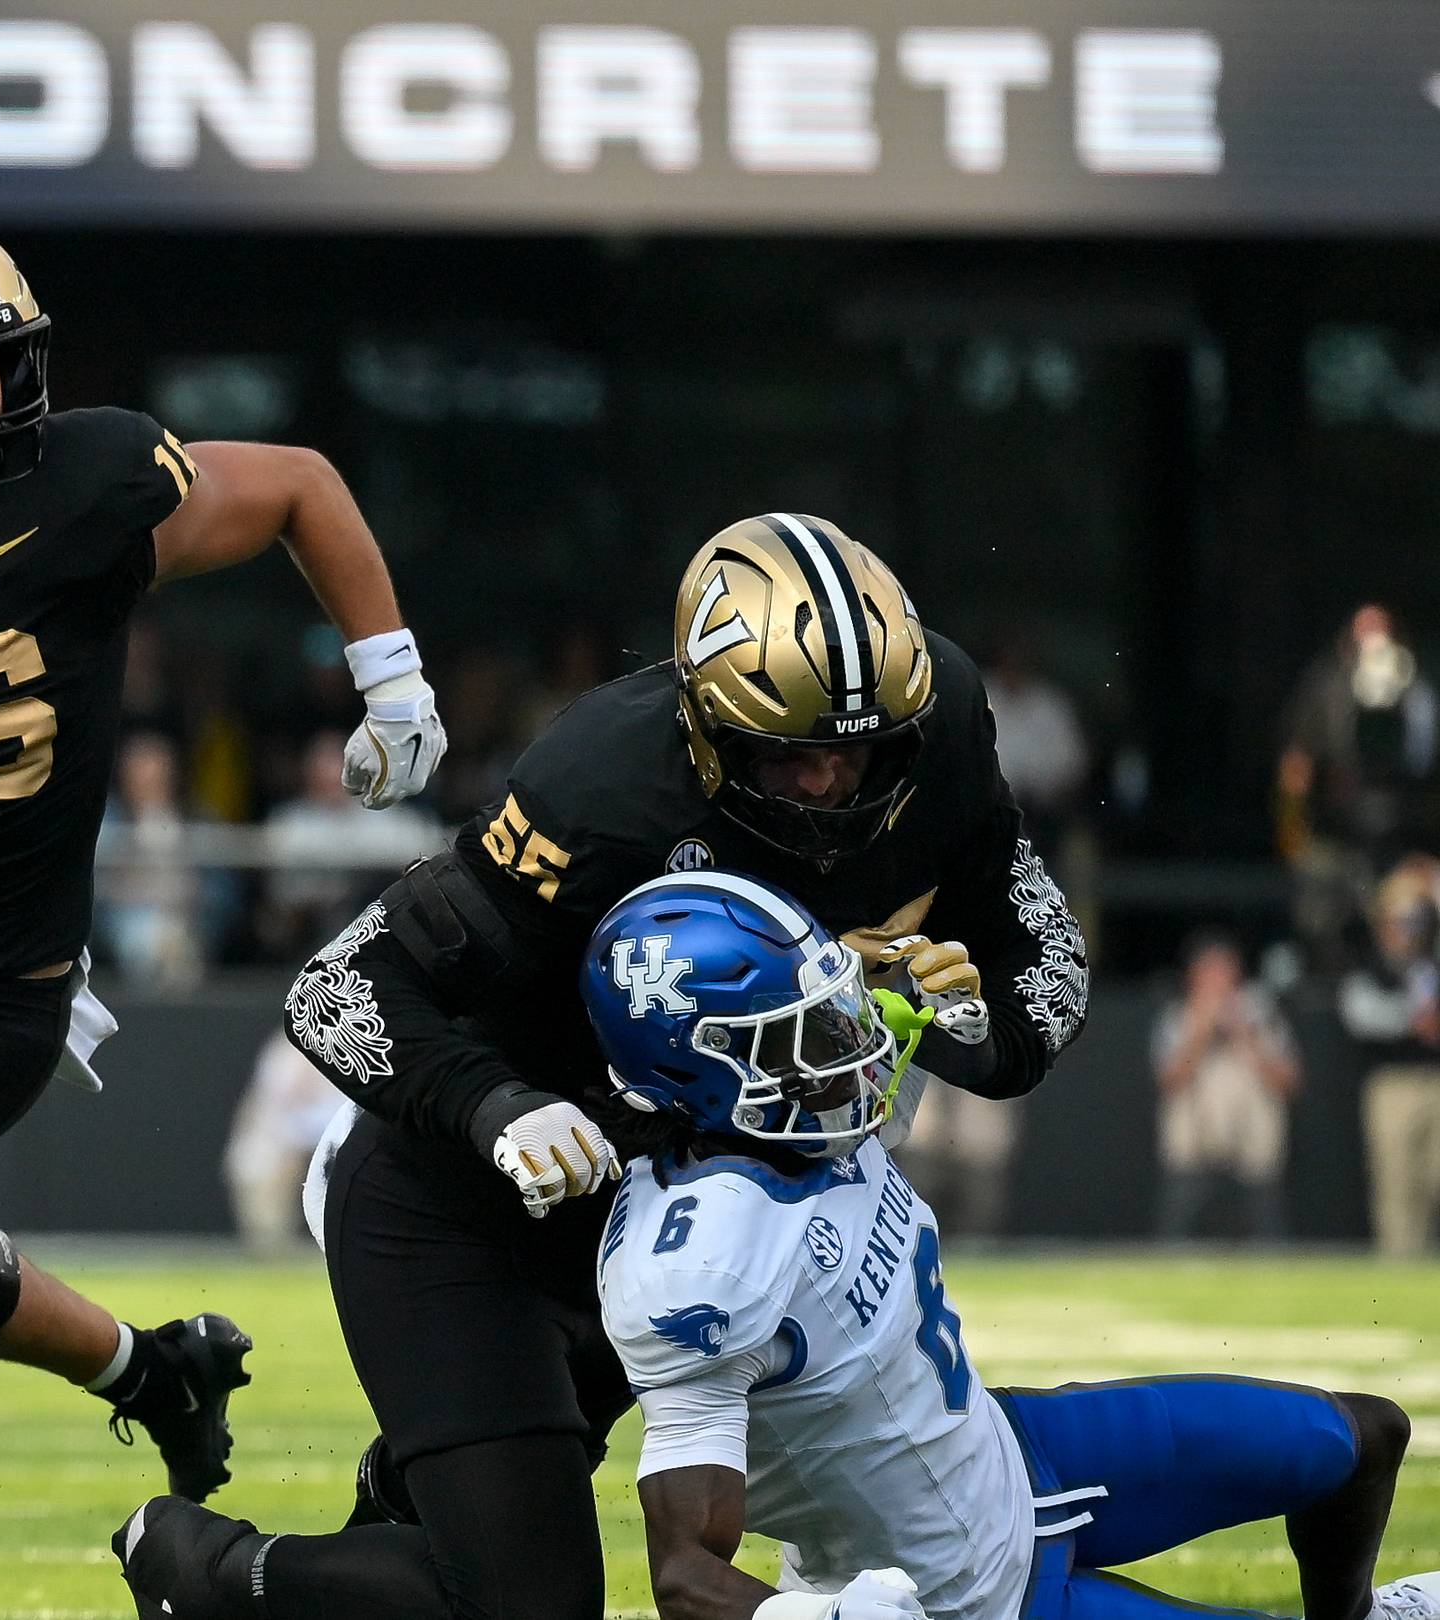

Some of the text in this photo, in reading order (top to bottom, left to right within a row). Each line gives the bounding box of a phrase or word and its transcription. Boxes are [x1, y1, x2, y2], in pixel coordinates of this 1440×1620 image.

[686, 567, 758, 669] V
[835, 714, 880, 734] VUFB
[611, 934, 698, 1019] UK
[651, 1196, 700, 1255] 6
[806, 1217, 843, 1269] SEC
[844, 1150, 914, 1328] KENTUC
